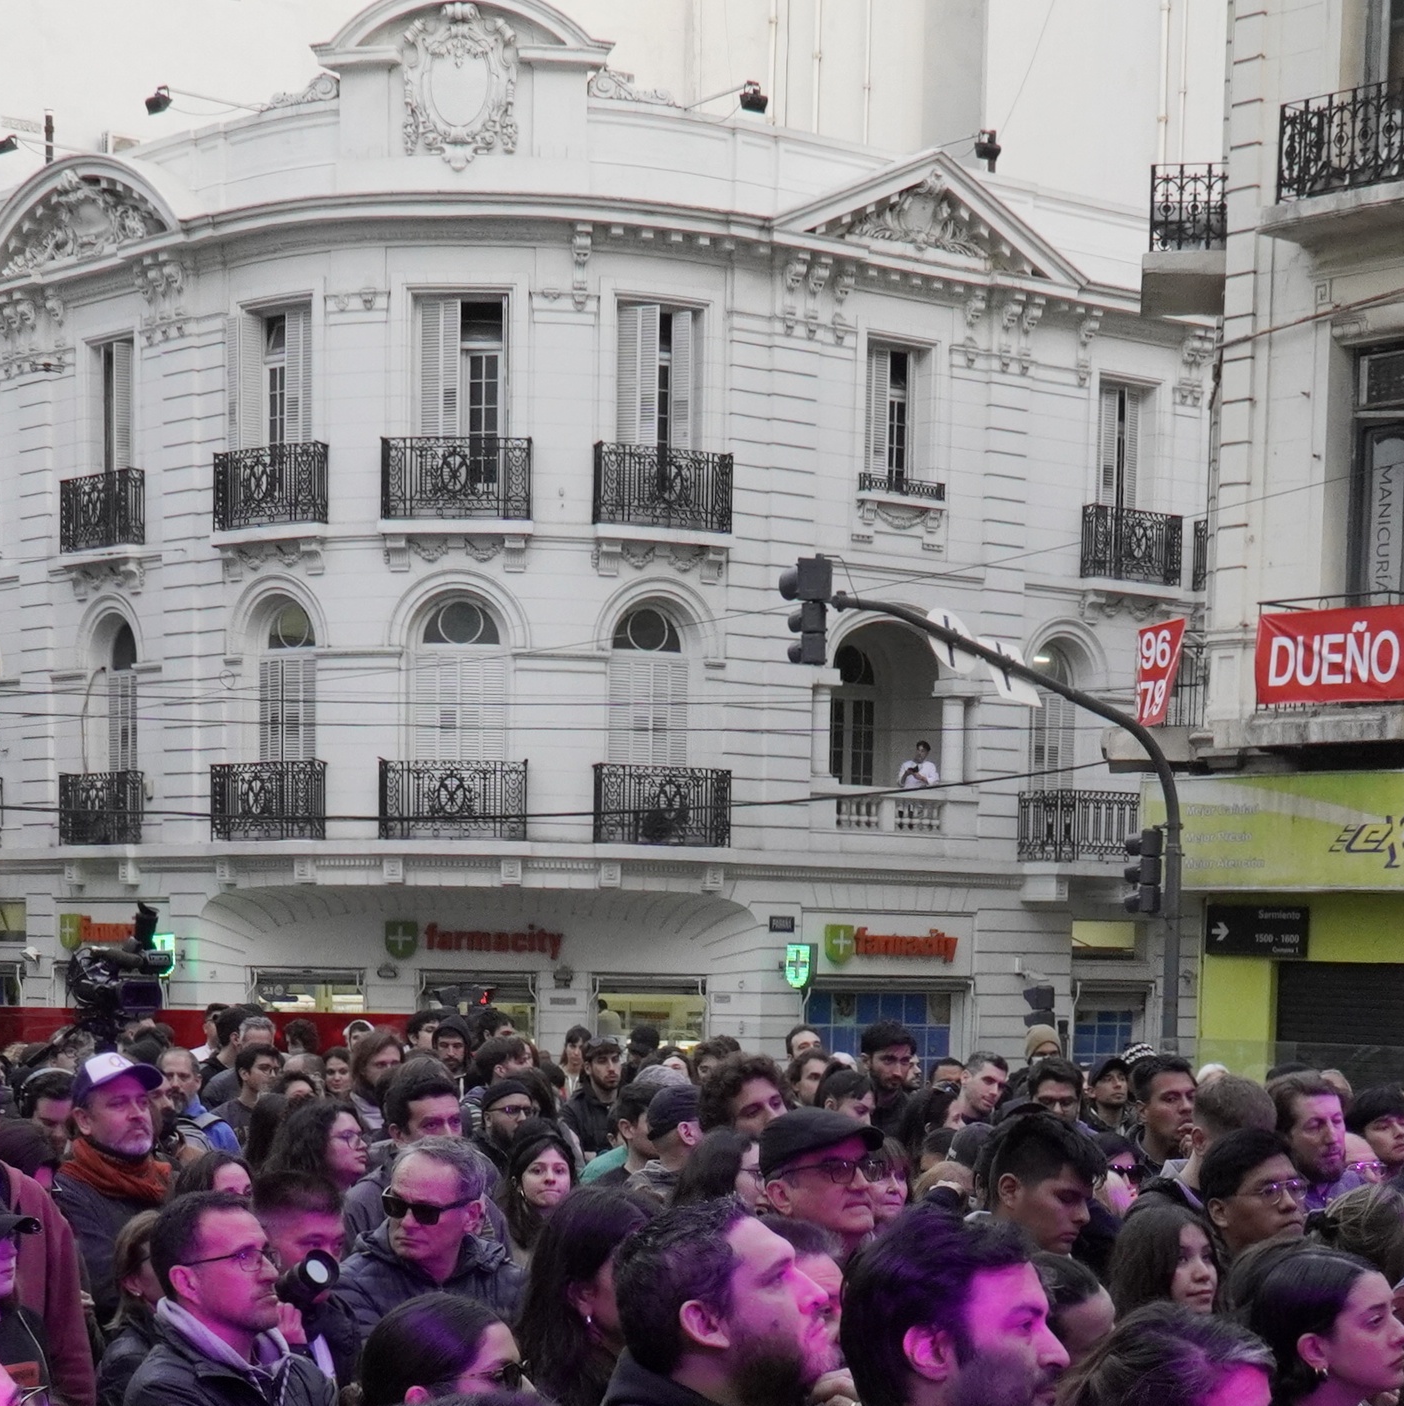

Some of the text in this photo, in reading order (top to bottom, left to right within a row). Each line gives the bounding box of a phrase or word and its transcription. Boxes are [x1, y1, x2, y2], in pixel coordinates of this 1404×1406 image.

[1268, 621, 1400, 687] DUEÑO
[1258, 909, 1301, 920] Sarmiento
[424, 921, 564, 961] farmacity
[854, 926, 959, 964] farmacity
[1255, 933, 1274, 943] 1500
